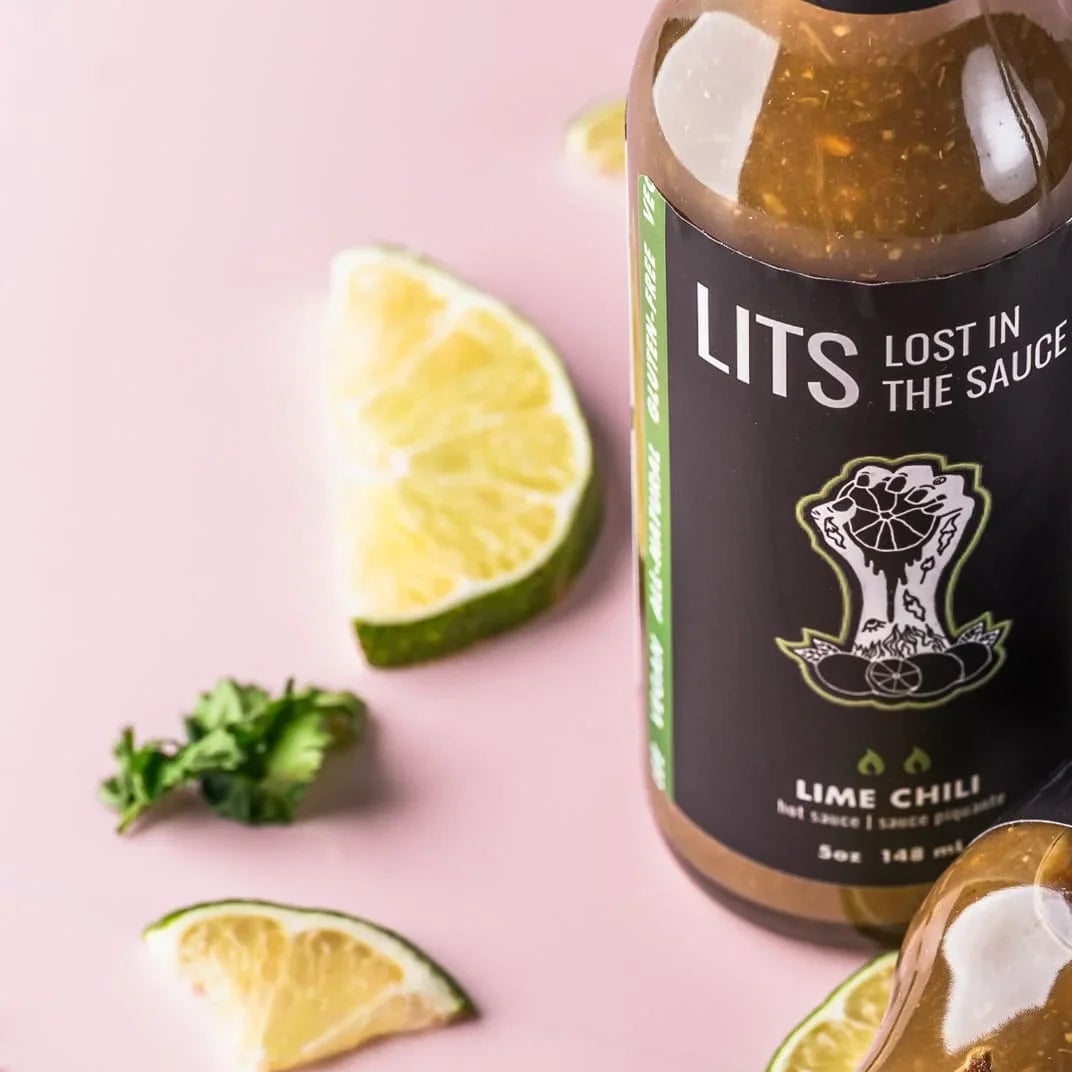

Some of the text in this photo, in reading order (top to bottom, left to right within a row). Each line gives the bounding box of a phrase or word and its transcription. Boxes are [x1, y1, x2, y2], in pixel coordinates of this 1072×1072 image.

[643, 240, 660, 424] GLUTEN-FREE
[697, 281, 859, 409] LITS
[885, 304, 1020, 368] LOST IN
[882, 319, 1068, 412] THE SAUCE
[776, 797, 805, 820] hot
[810, 809, 860, 829] sauce
[878, 813, 929, 830] sauce
[795, 773, 982, 809] LIME CHILI
[817, 843, 862, 864] 5oz
[880, 847, 925, 864] 148
